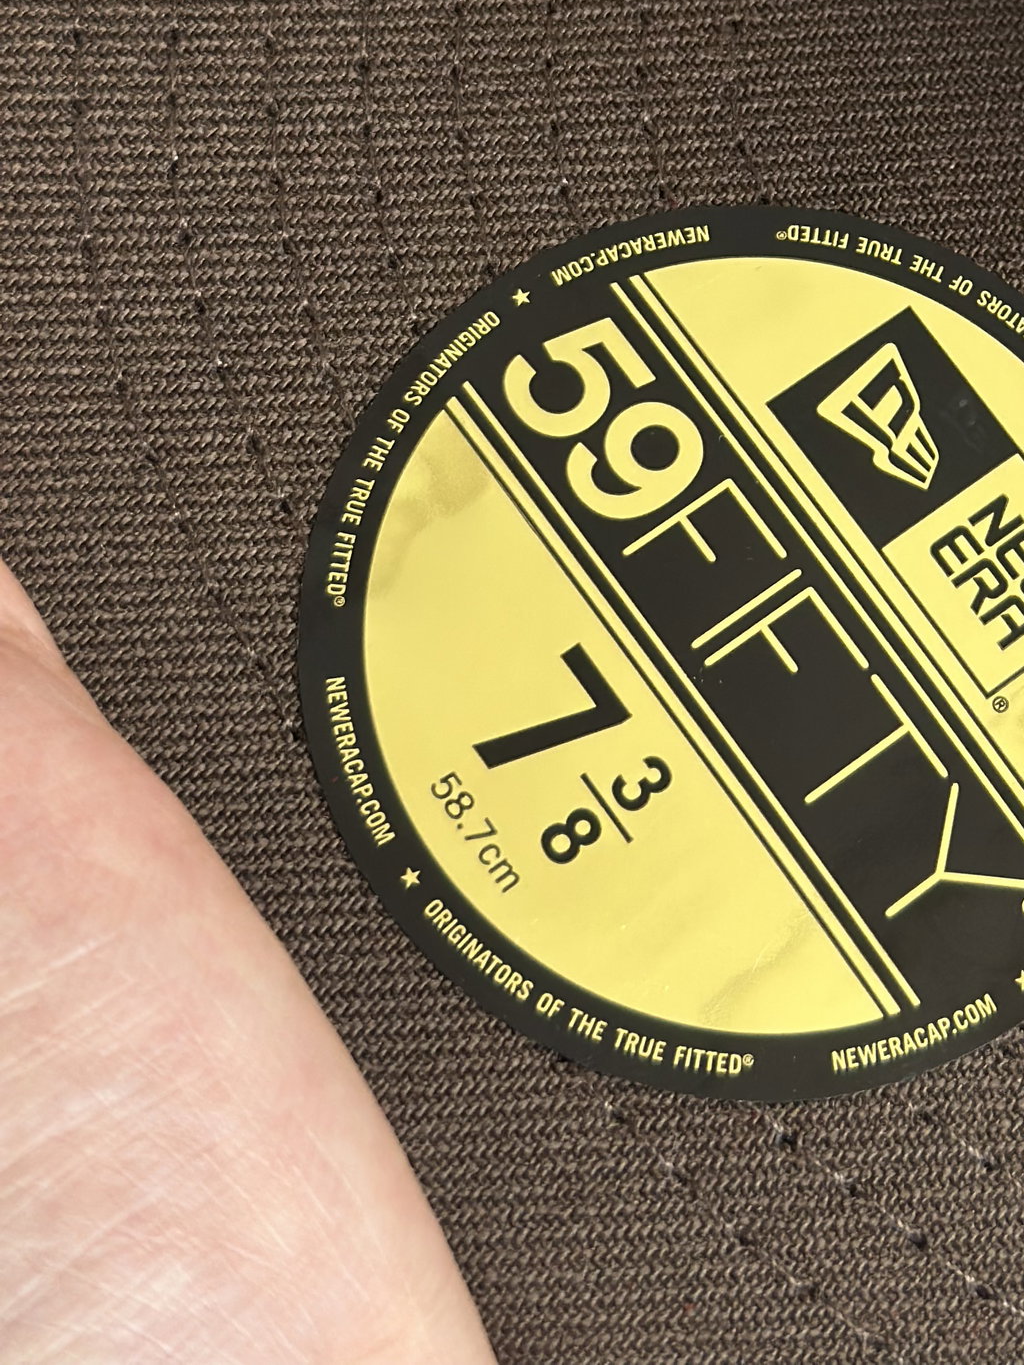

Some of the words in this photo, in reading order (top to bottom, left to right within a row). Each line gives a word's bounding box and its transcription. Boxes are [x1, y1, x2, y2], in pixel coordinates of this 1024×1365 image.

[551, 225, 710, 287] NEWERACAP.COM
[857, 236, 902, 266] TRUE
[909, 254, 944, 283] THE
[949, 274, 973, 296] OF
[404, 310, 500, 406] ORIGINATORS
[386, 408, 410, 433] OF
[362, 435, 395, 472] THE
[341, 476, 376, 526] TRUE
[325, 676, 395, 847] NEWERACAP.COM
[431, 771, 520, 894] 58.7cm
[424, 899, 534, 1001] ORIGINATORS
[536, 992, 564, 1022] OF
[568, 1007, 607, 1041] THE
[615, 1028, 665, 1061] TRUE
[831, 994, 997, 1072] NEWERACAP.COM
